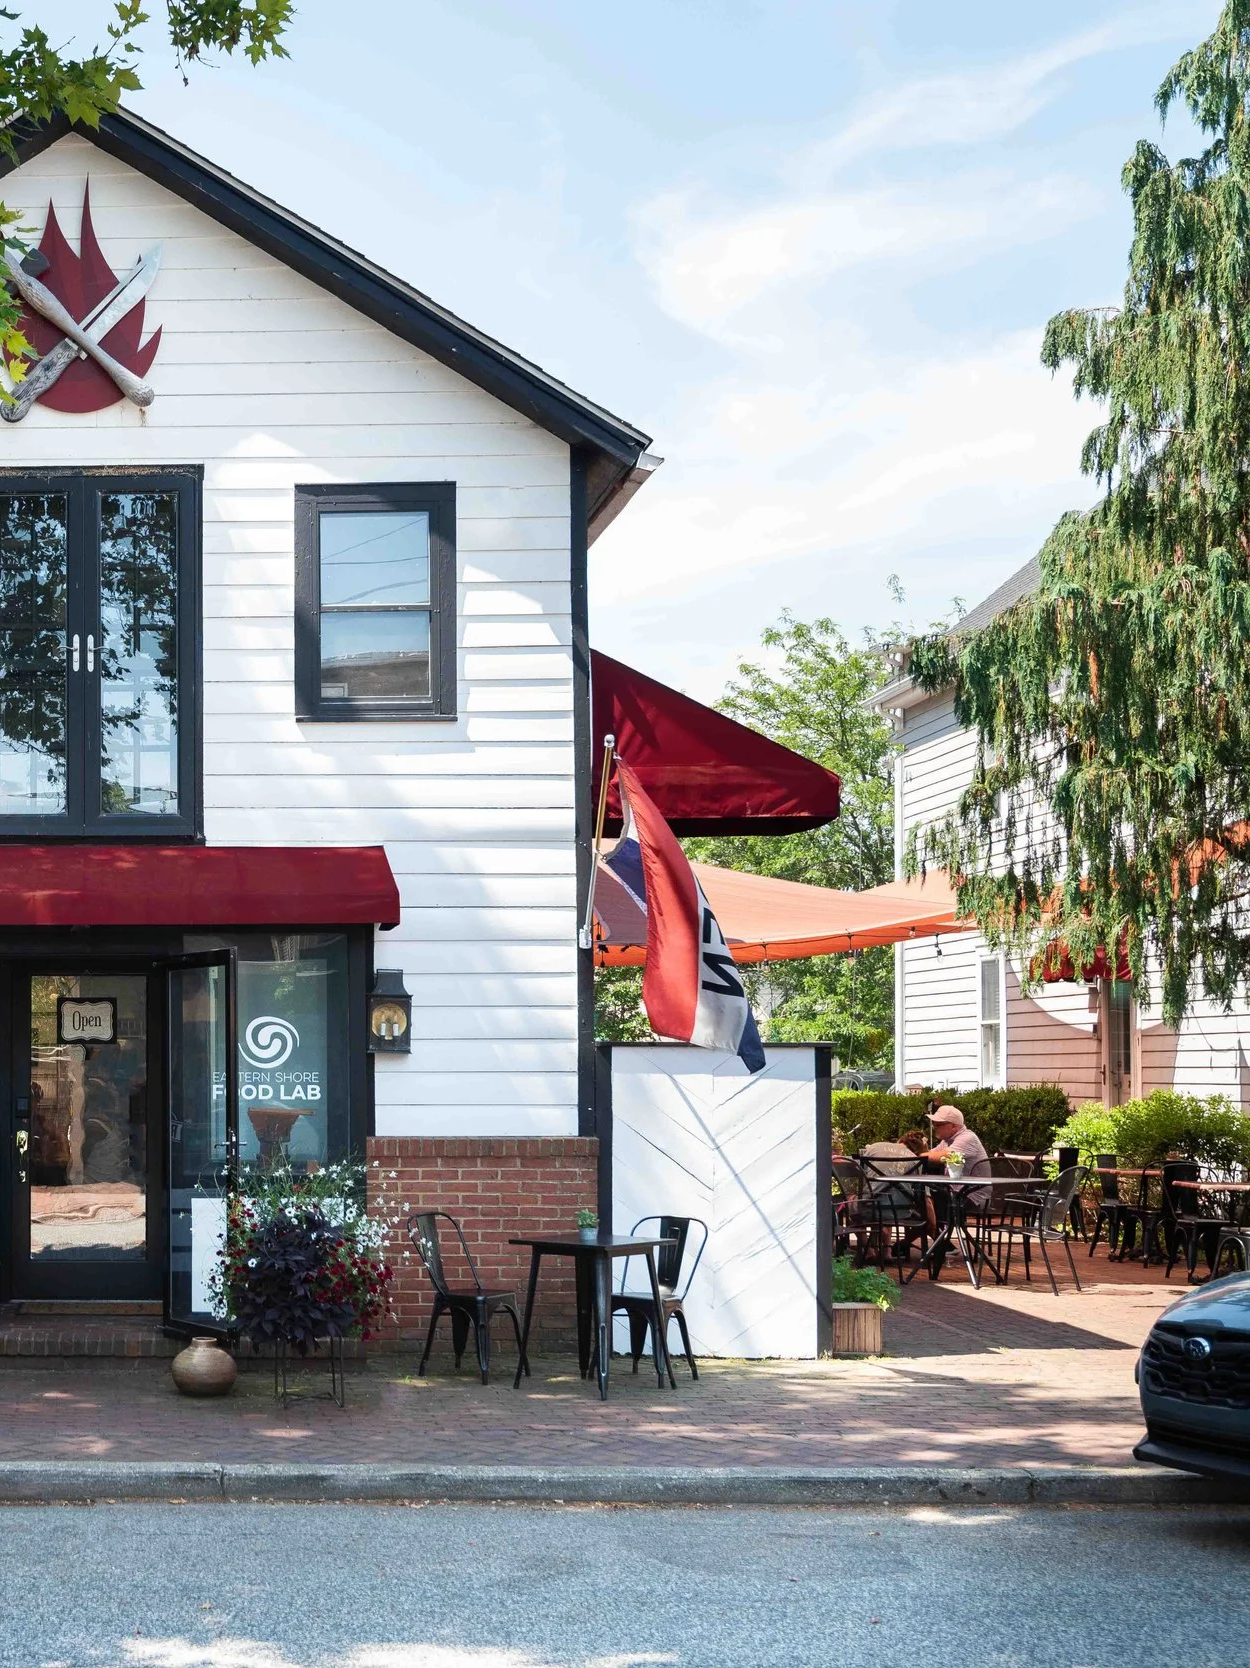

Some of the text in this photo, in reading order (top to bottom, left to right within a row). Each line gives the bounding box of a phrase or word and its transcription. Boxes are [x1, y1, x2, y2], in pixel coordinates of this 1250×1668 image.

[72, 1010, 102, 1031] Open
[212, 1072, 320, 1083] EATERN SHORE
[212, 1084, 322, 1100] FOD LAB
